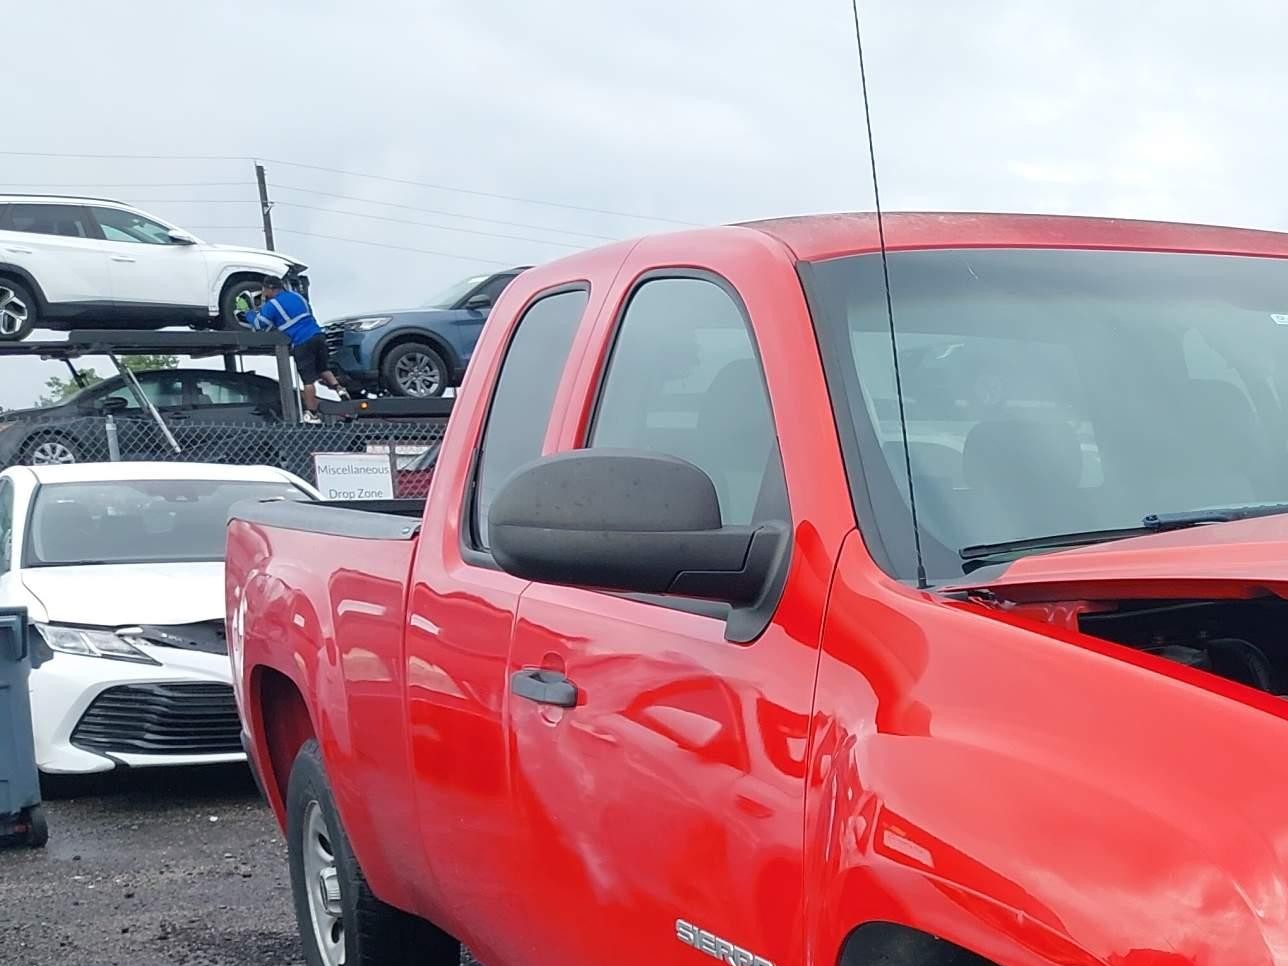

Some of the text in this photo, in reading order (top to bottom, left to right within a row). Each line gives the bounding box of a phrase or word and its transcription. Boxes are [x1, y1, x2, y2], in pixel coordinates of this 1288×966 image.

[318, 465, 389, 475] Miscellaneous
[329, 488, 383, 499] Drop Zone
